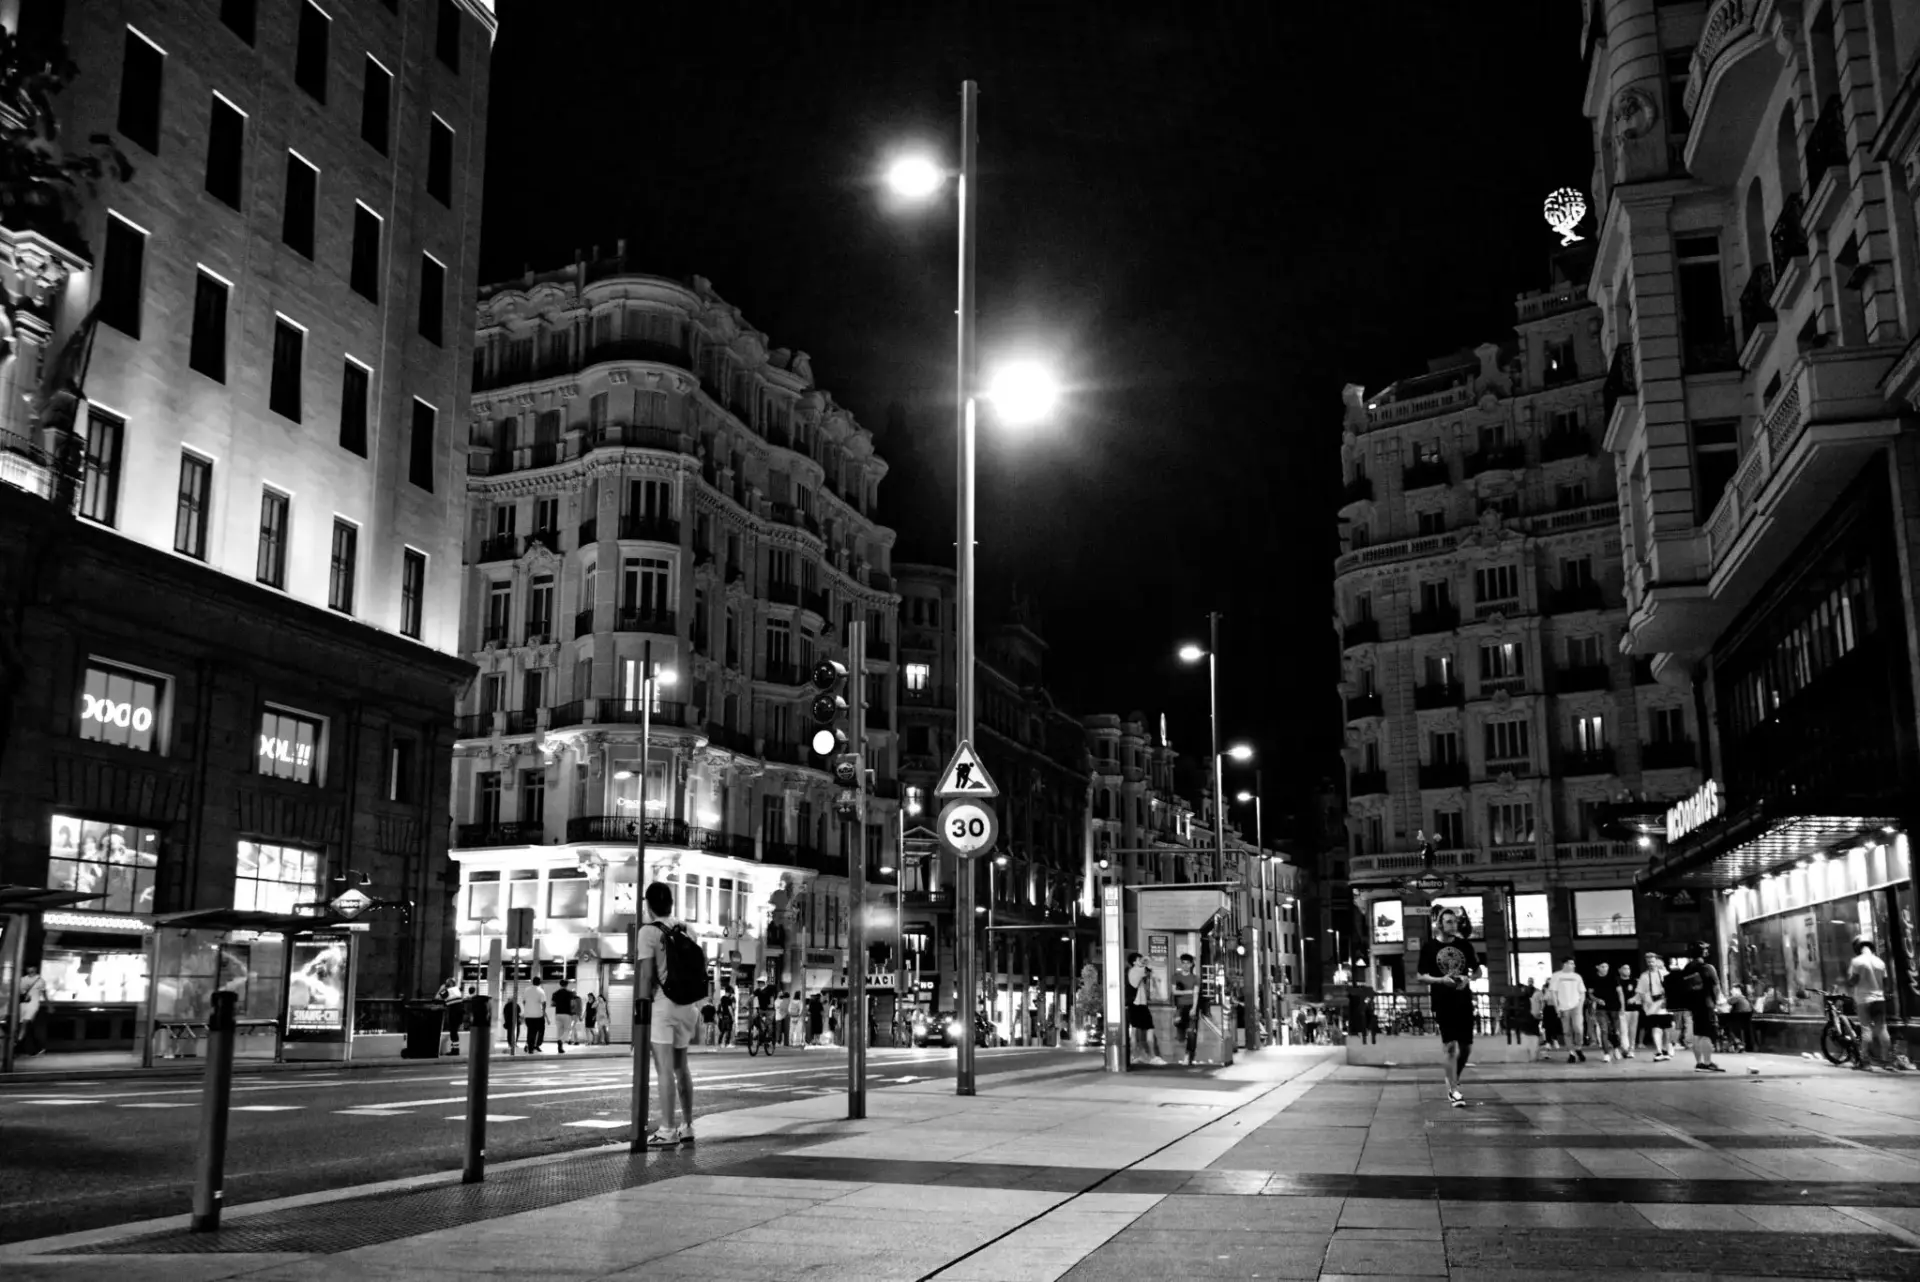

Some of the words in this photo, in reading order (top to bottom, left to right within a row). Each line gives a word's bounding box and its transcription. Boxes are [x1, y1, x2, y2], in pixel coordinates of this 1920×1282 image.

[1667, 778, 1718, 843] McDonald's
[952, 817, 985, 838] 30
[1418, 879, 1443, 888] Metro
